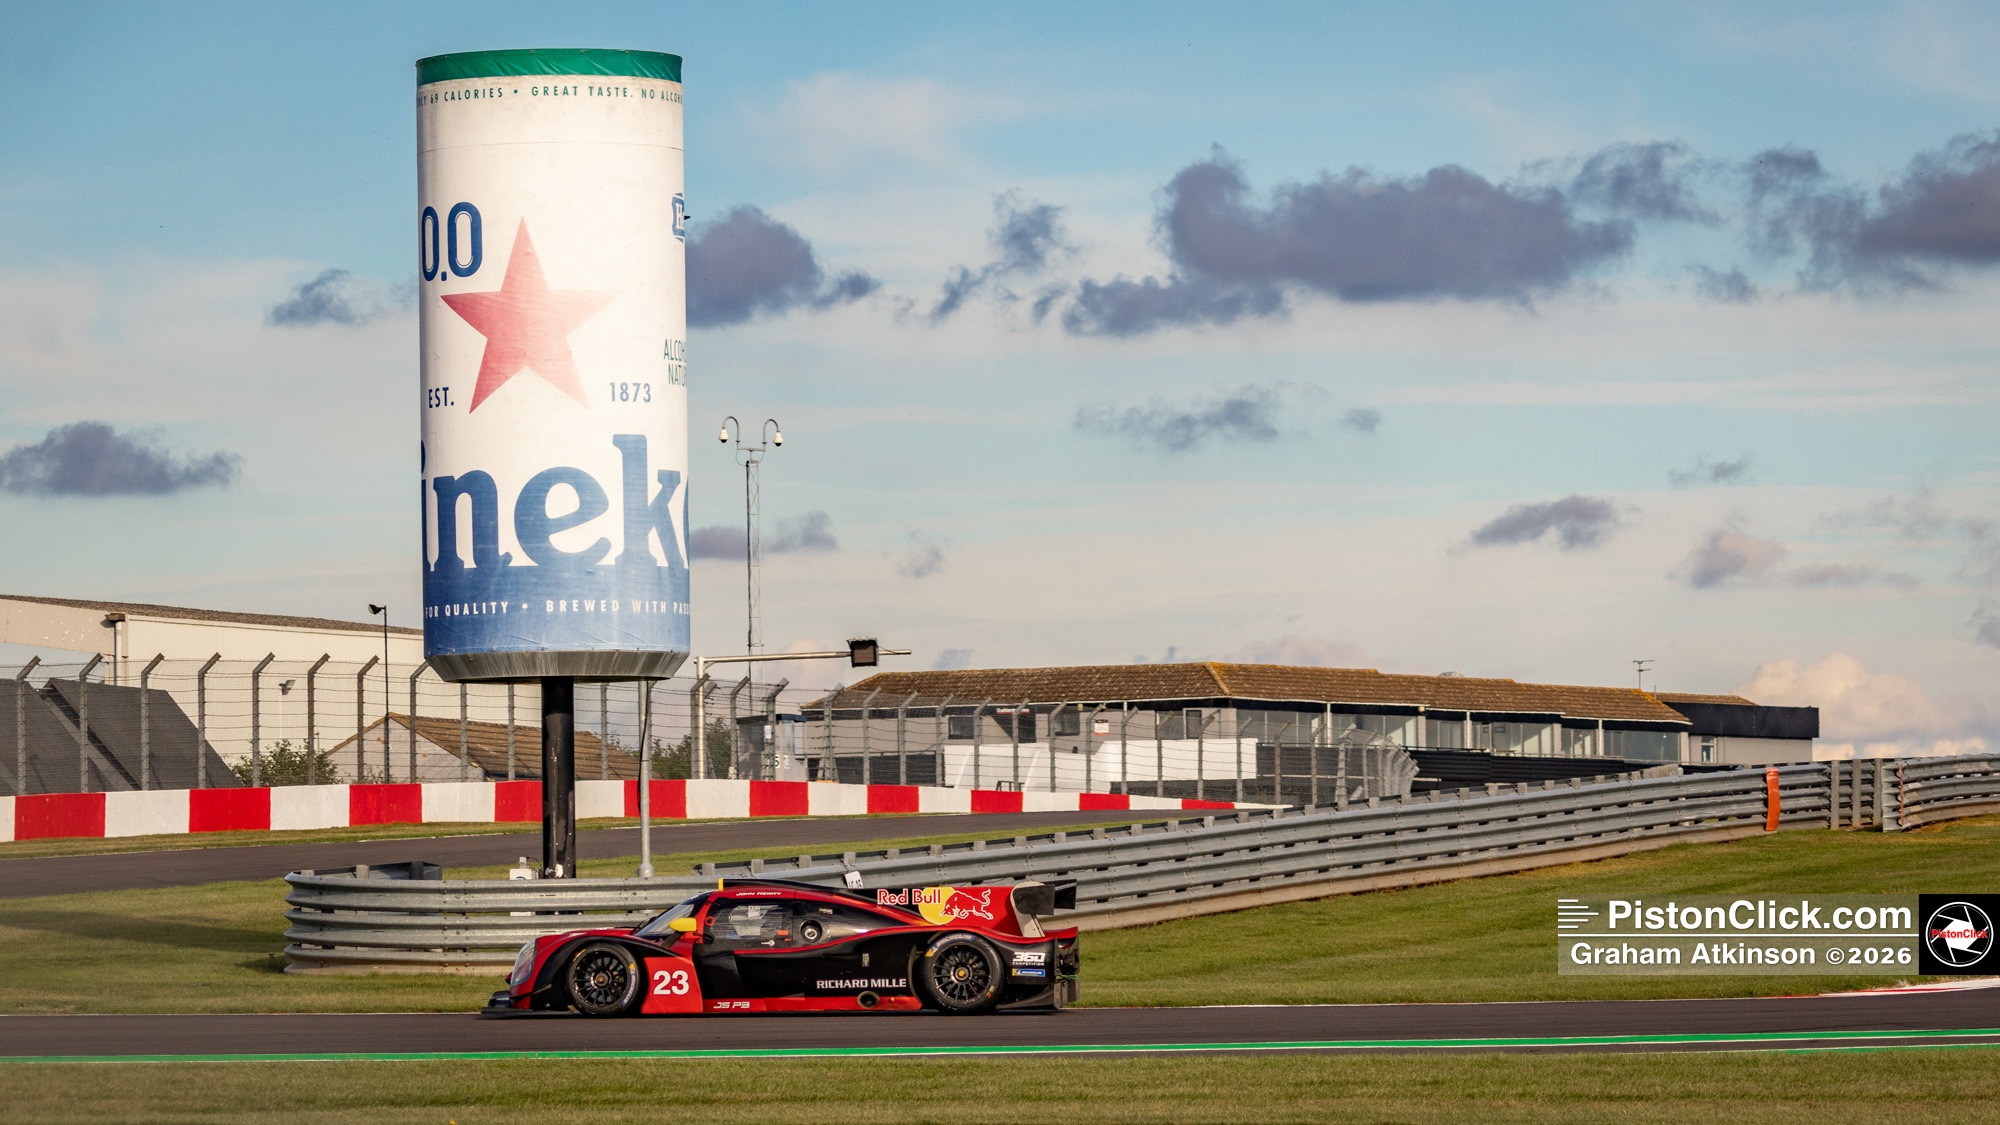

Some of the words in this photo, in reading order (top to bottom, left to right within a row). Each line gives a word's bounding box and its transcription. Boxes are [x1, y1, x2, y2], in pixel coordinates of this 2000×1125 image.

[430, 93, 439, 105] 69
[444, 87, 503, 102] CALORIES
[531, 86, 578, 97] GREAT
[588, 86, 634, 98] TASTE.
[641, 88, 655, 99] NO
[421, 201, 483, 282] 0.0
[428, 386, 455, 409] EST.
[610, 381, 652, 404] 1873
[424, 605, 439, 619] FOR
[444, 601, 509, 617] QUALITY
[545, 600, 620, 613] BREWED
[632, 600, 666, 613] WITH
[877, 888, 909, 905] Red
[912, 888, 942, 905] Bull
[1012, 951, 1046, 963] 360
[653, 970, 690, 995] 23
[816, 979, 868, 989] RICHARD
[870, 978, 907, 988] MILLE
